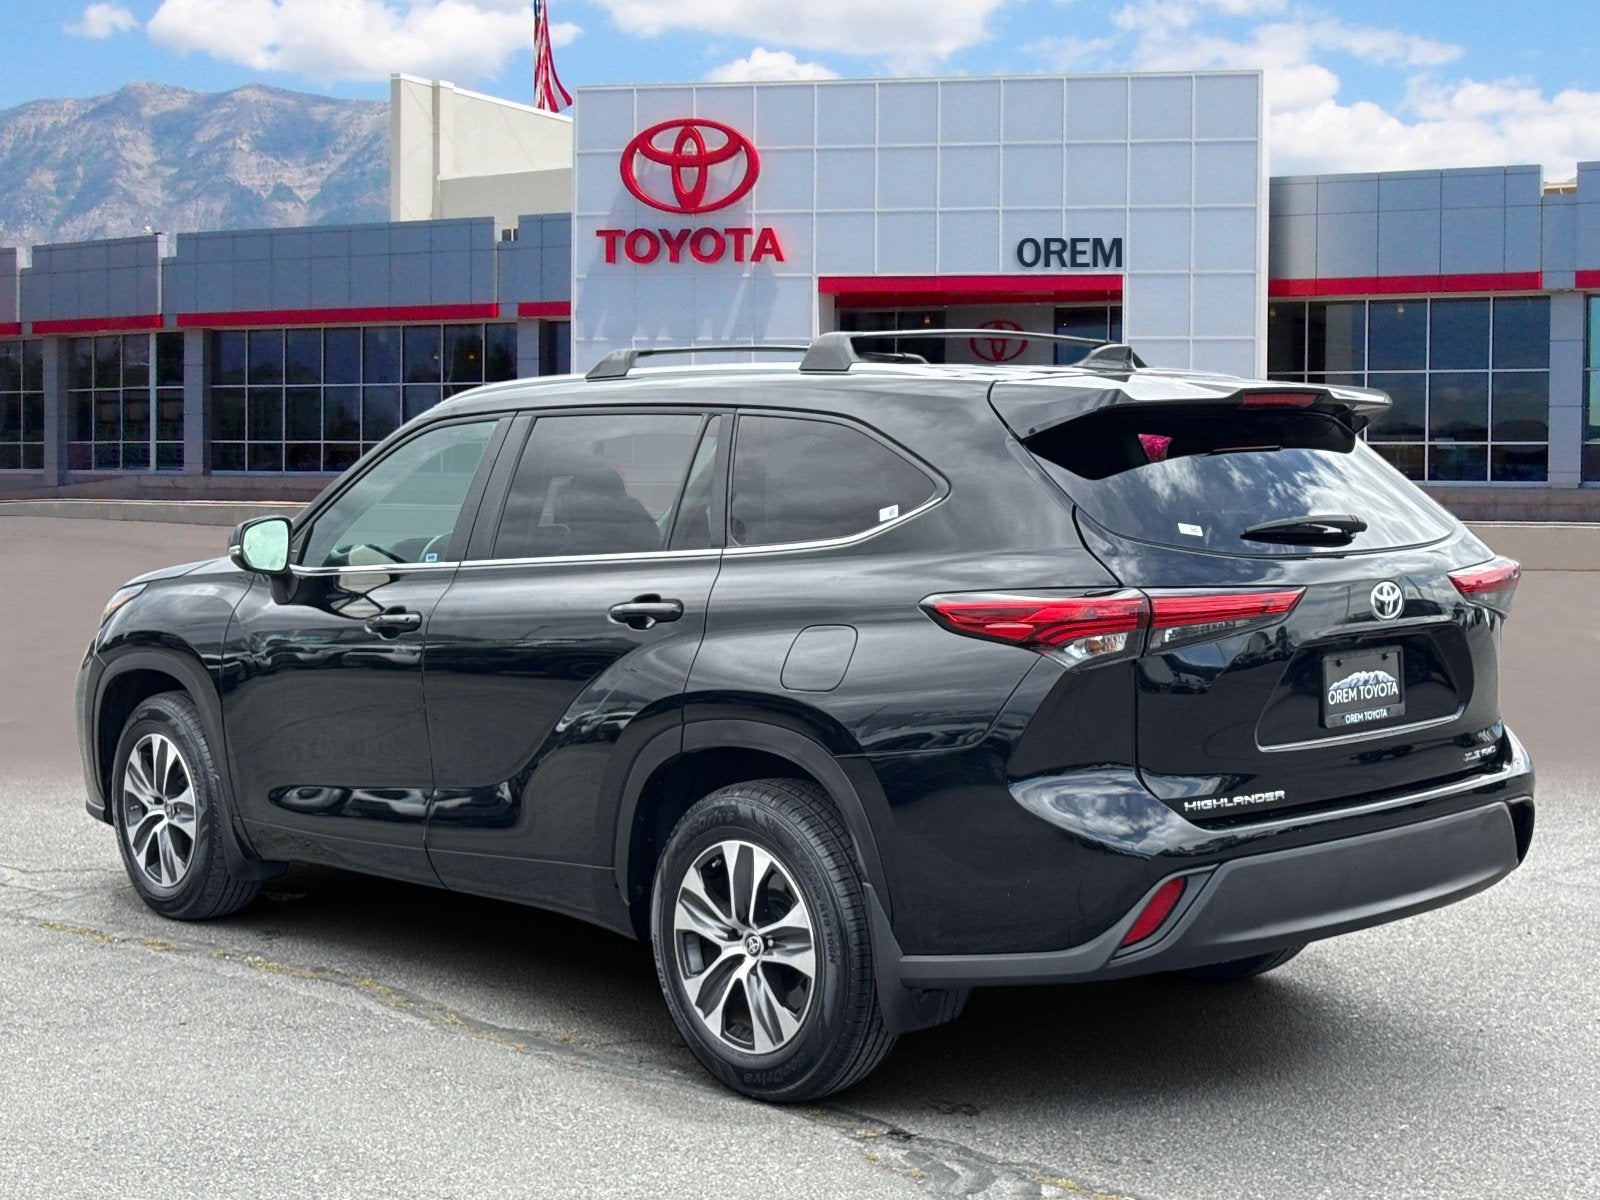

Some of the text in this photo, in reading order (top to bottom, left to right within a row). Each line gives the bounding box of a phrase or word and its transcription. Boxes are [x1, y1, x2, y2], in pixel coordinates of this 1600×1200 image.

[596, 227, 785, 265] TOYOTA
[1016, 237, 1123, 268] OREM
[1328, 681, 1399, 705] OREM TOYOTA
[1345, 708, 1388, 724] OREM TOYOTA
[1184, 790, 1285, 811] HIGHLANDER
